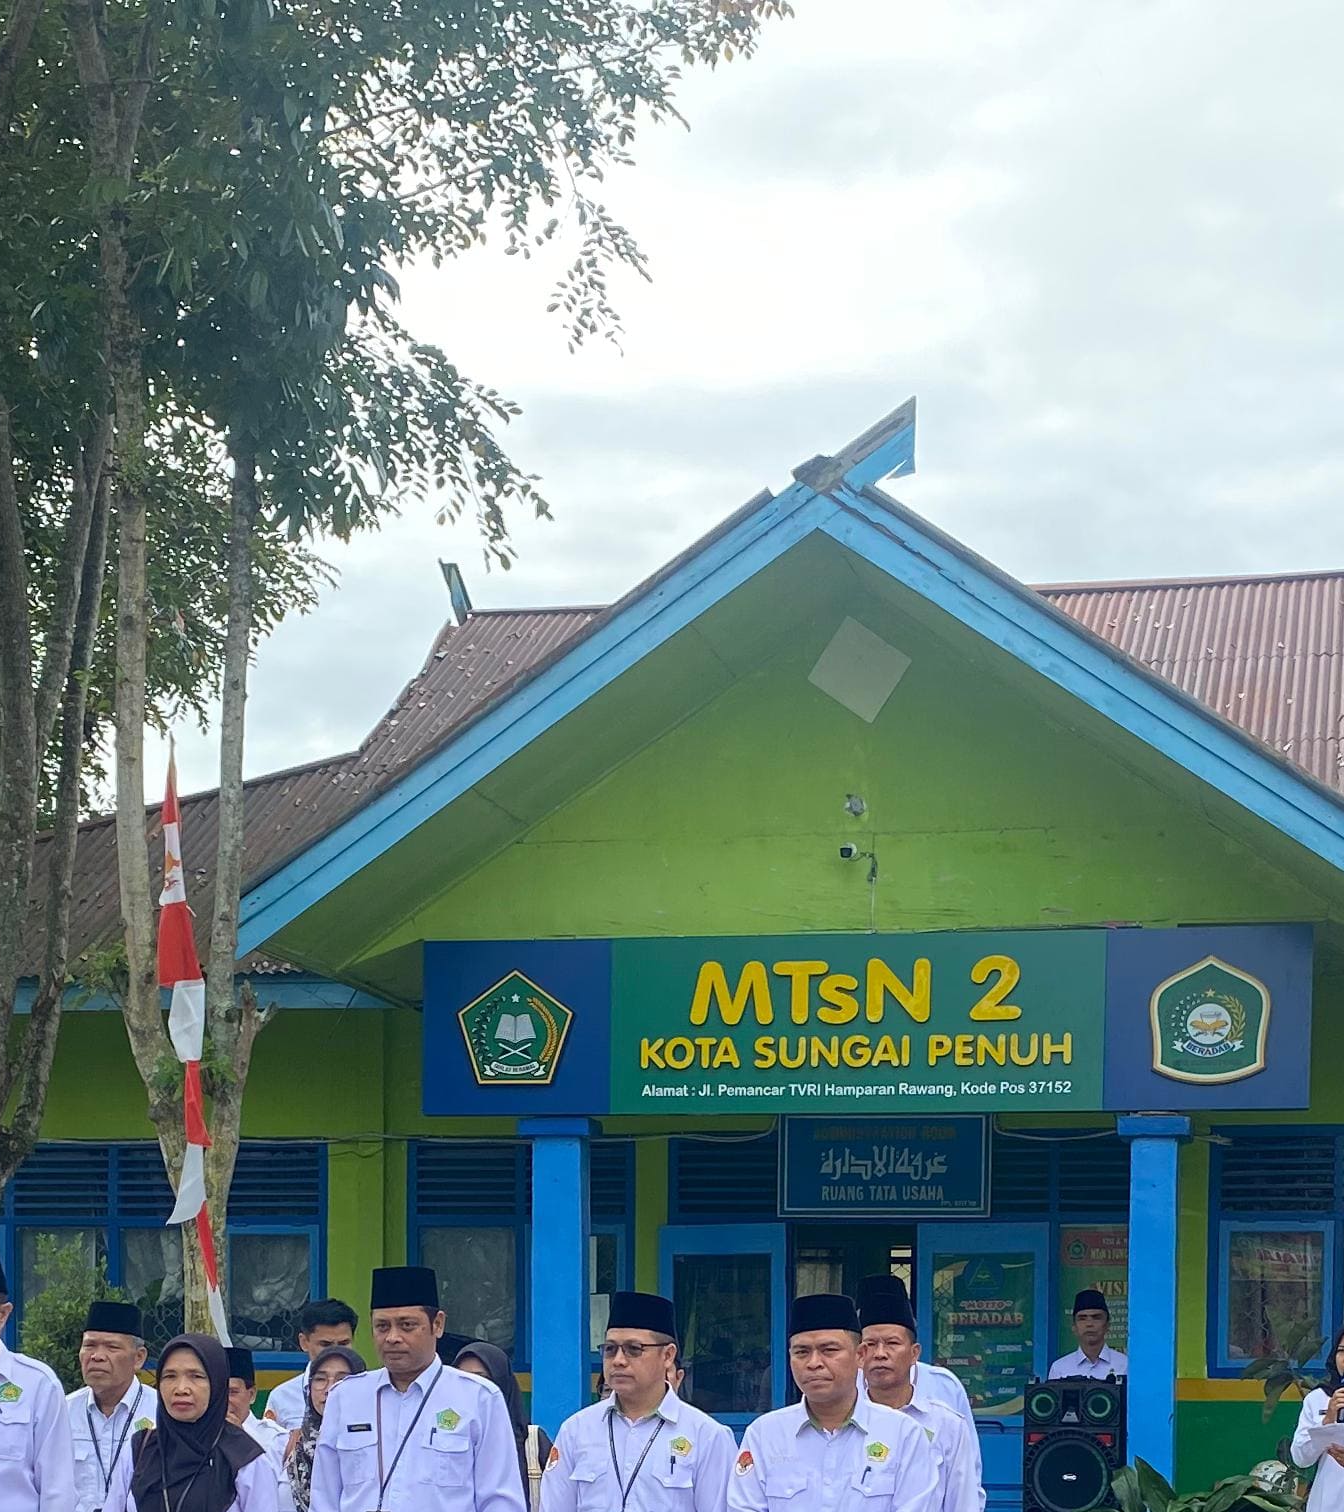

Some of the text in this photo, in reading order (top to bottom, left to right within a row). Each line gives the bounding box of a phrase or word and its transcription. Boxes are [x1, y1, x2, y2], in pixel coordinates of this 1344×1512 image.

[689, 954, 1023, 1025] MTsN 2
[639, 1032, 1072, 1069] KOTA SUNGAI PENUH
[641, 1084, 688, 1097] Alamat
[718, 1084, 786, 1096] Pemancar
[788, 1083, 821, 1096] TVRI
[824, 1083, 895, 1098] Hamparan
[898, 1082, 957, 1097] Rawang,
[960, 1081, 997, 1094] Kode
[999, 1081, 1025, 1094] Pos
[1028, 1081, 1071, 1093] 37152
[821, 1185, 944, 1201] RUANG TATA USAHA
